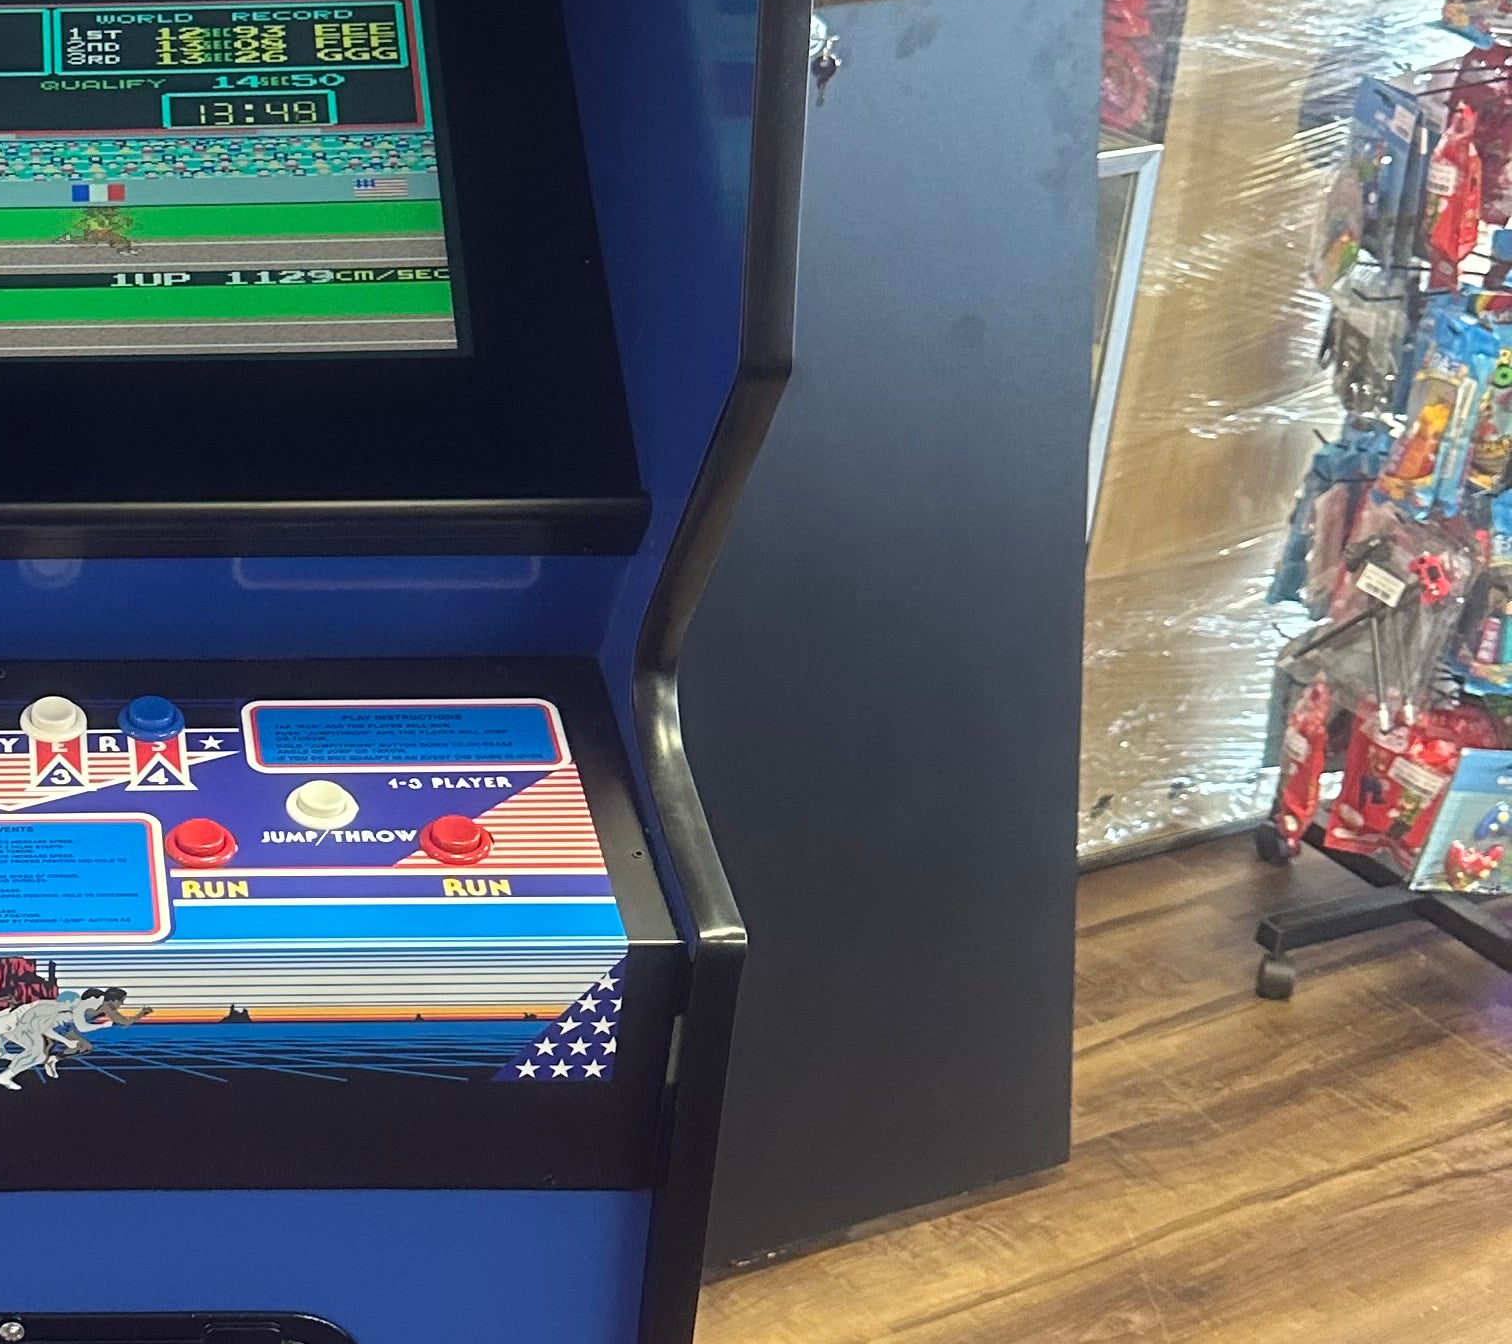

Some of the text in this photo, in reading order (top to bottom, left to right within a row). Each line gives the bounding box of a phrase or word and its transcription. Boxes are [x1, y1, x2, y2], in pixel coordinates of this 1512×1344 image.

[95, 9, 354, 26] WORLD RECORD
[69, 27, 123, 41] 1ST
[66, 40, 120, 53] 2ND
[316, 47, 399, 63] GGG
[40, 78, 167, 92] QUALIFY
[109, 272, 192, 288] 1UP
[51, 768, 72, 785] 3
[147, 768, 169, 785] 4
[388, 776, 513, 790] 1-3 PLAYER
[261, 828, 418, 847] JUMP/THROW
[181, 879, 250, 899] RUN
[441, 877, 513, 897] RUN
